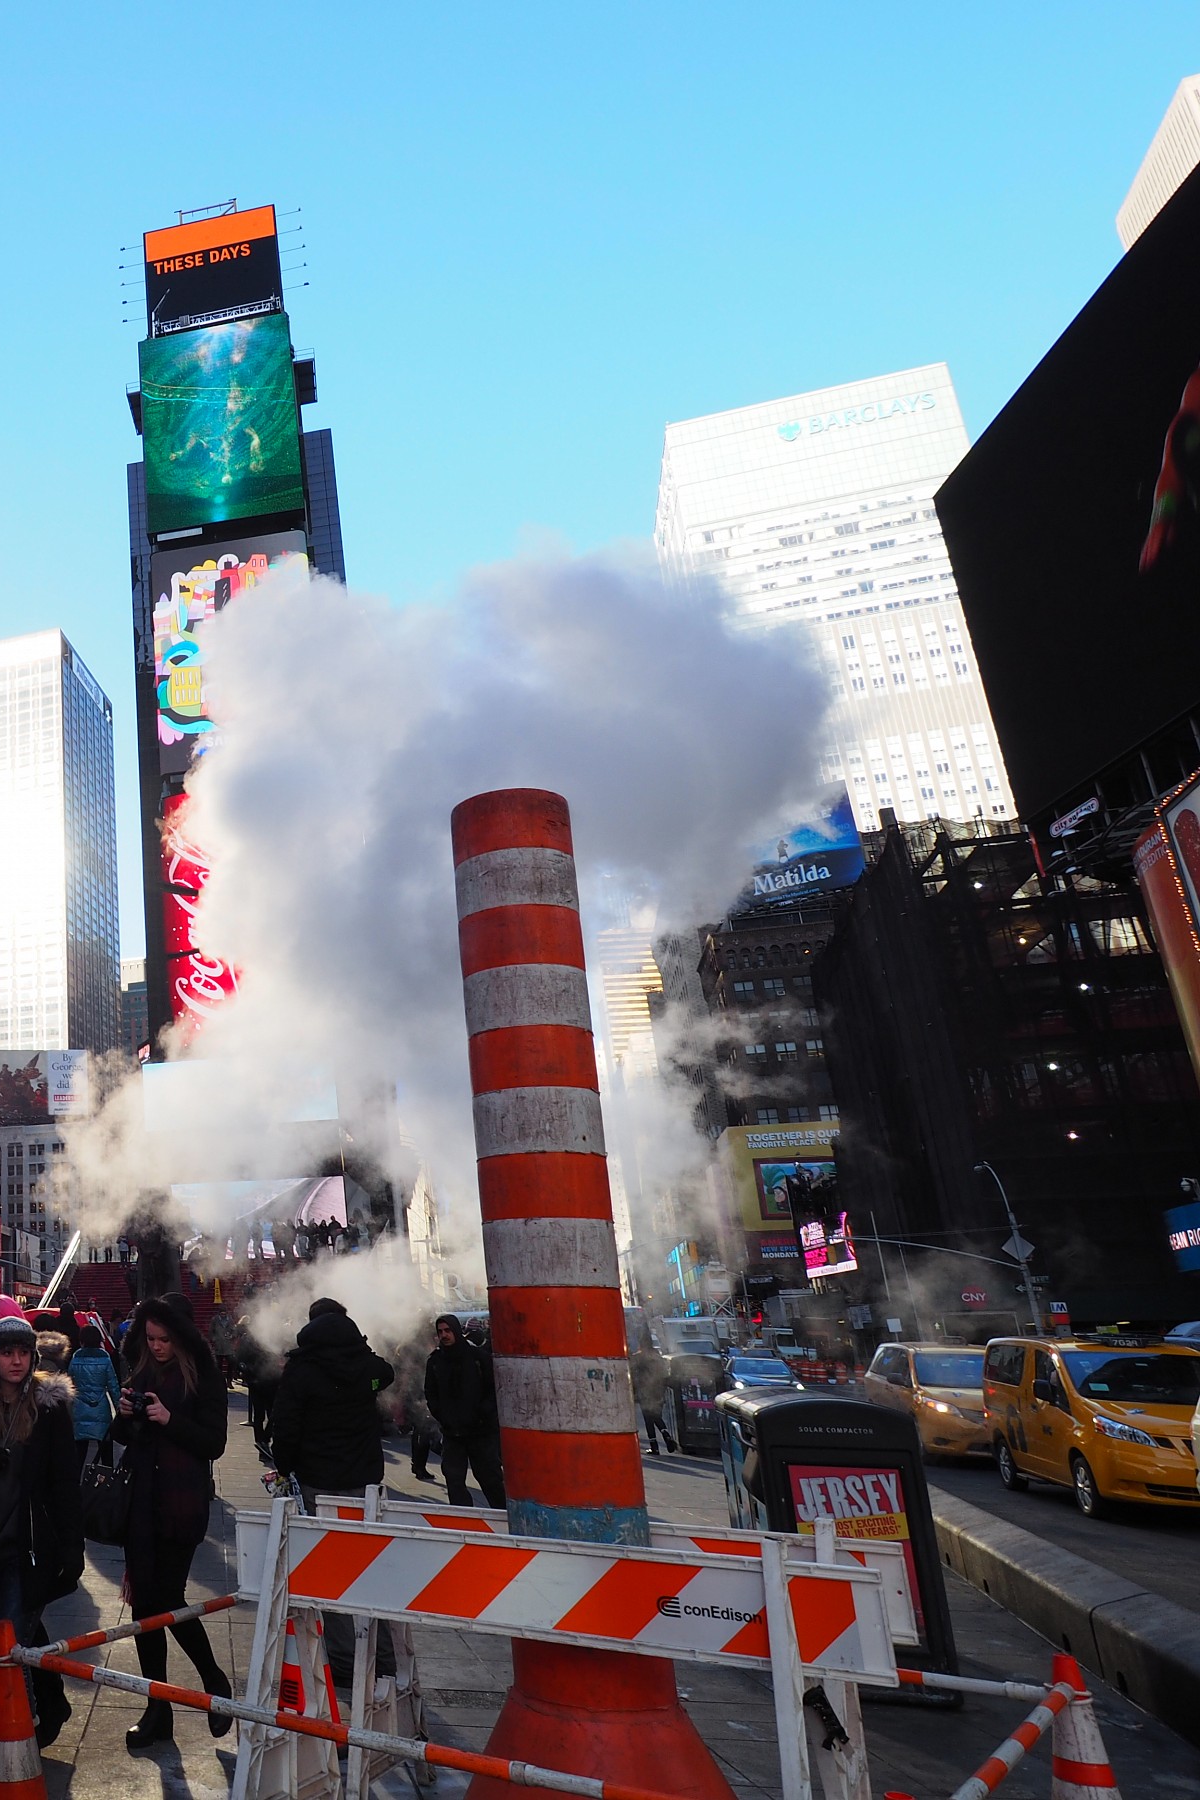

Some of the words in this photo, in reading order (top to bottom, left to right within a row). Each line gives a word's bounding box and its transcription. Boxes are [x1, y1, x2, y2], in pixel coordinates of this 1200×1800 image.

[153, 252, 205, 276] THESE
[209, 243, 252, 265] DAYS
[808, 393, 937, 436] BARCLAYS
[1053, 817, 1067, 833] city
[1067, 801, 1096, 825] outdoor
[752, 863, 832, 897] Matilda
[62, 1053, 73, 1063] By
[56, 1080, 70, 1089] did
[745, 1129, 803, 1142] TOGETHER
[804, 1129, 816, 1139] IS
[747, 1139, 787, 1150] FAVORITE
[788, 1138, 816, 1148] PLACE
[816, 1137, 831, 1146] TO
[761, 1251, 800, 1259] MONDAYS
[961, 1292, 987, 1302] CNY
[798, 1426, 824, 1434] SOLAR
[825, 1426, 874, 1435] COMPACTOR
[796, 1473, 900, 1523] JERSEY
[856, 1515, 896, 1529] EXCITING
[855, 1528, 864, 1539] IN
[683, 1603, 763, 1625] conEdison
